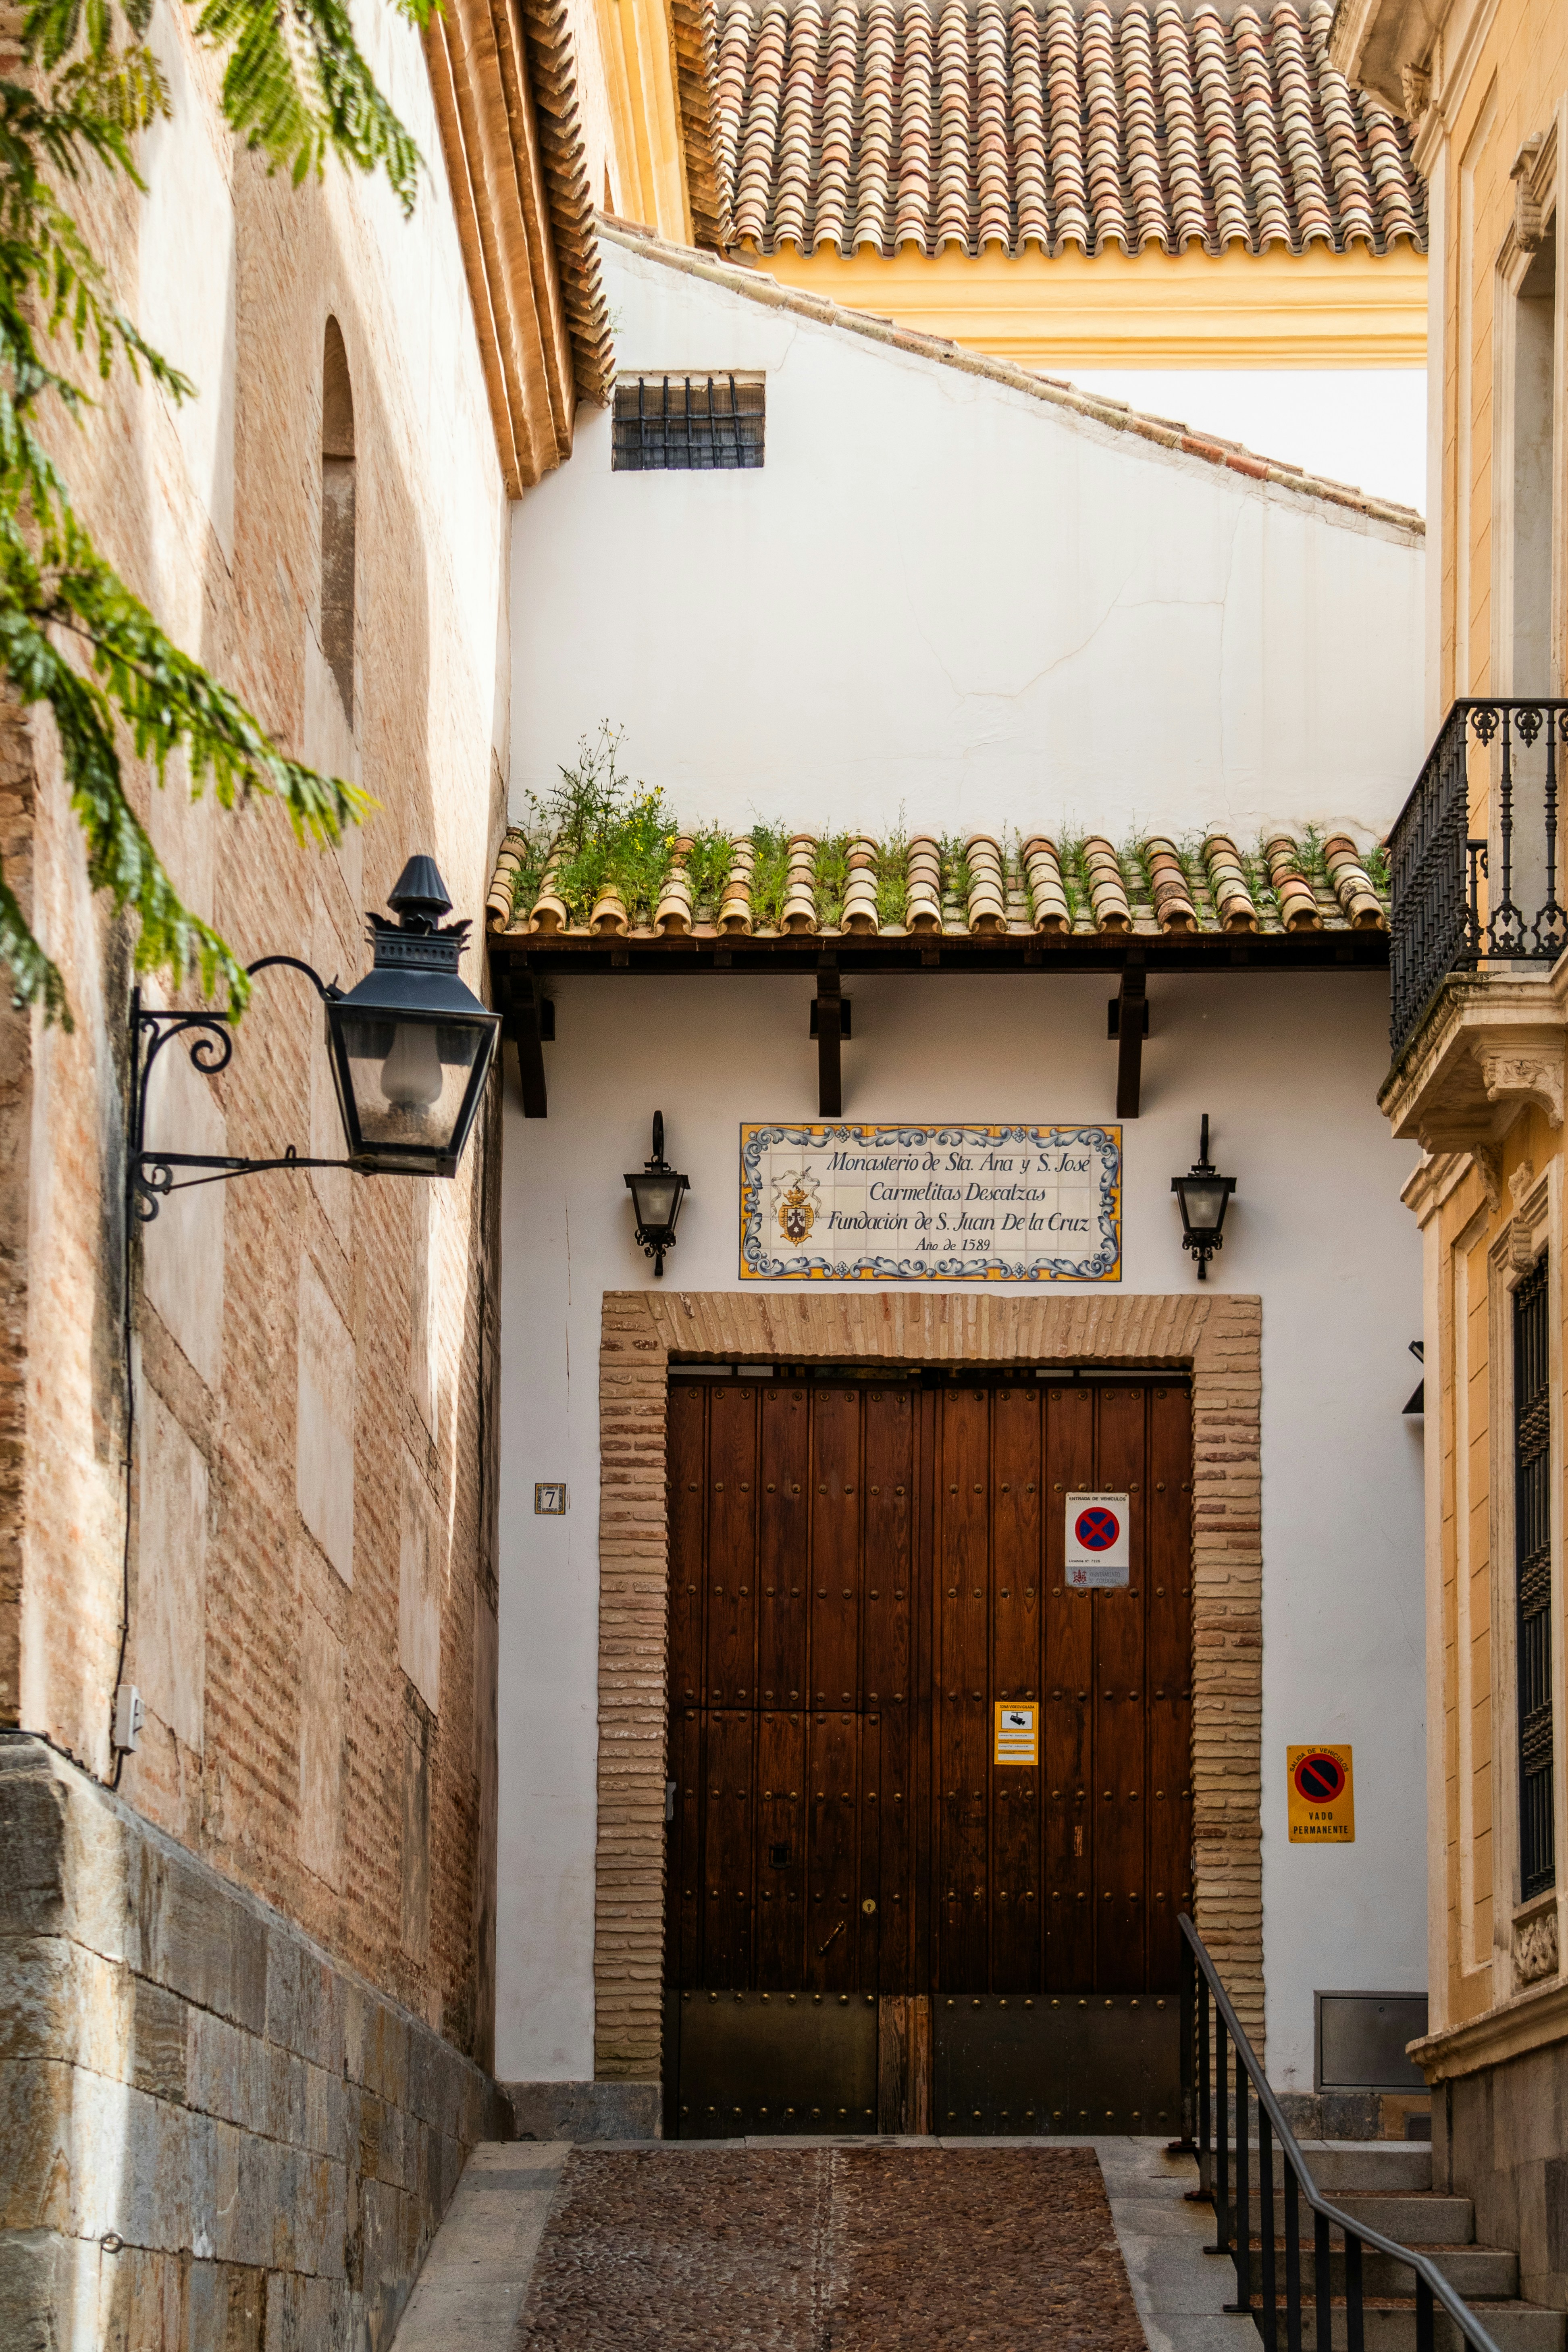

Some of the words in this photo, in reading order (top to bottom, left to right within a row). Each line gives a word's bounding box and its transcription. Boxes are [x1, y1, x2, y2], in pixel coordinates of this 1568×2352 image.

[827, 1152, 919, 1171] Monasterio
[922, 1152, 940, 1171] de
[945, 1152, 973, 1171] Sta.
[978, 1152, 1013, 1171] Ana
[1020, 1159, 1030, 1174] y
[1037, 1153, 1050, 1172] S.
[1055, 1153, 1091, 1172] José
[870, 1181, 961, 1200] Carmelitas
[964, 1183, 1045, 1201] Descalzas
[827, 1211, 908, 1230] Fundación
[914, 1211, 932, 1230] de
[936, 1212, 949, 1230] S.
[953, 1212, 995, 1231] Juan
[1000, 1213, 1025, 1230] De
[1028, 1212, 1044, 1230] la
[1048, 1212, 1090, 1231] Cruz
[915, 1237, 938, 1250] Año
[943, 1238, 956, 1250] de
[962, 1239, 990, 1251] 1589
[545, 1491, 555, 1507] 7
[1290, 1753, 1306, 1772] SALIDA
[1320, 1748, 1349, 1772] VEHICULOS
[1309, 1812, 1333, 1820] VADO
[1293, 1826, 1348, 1834] PERMANENTE
